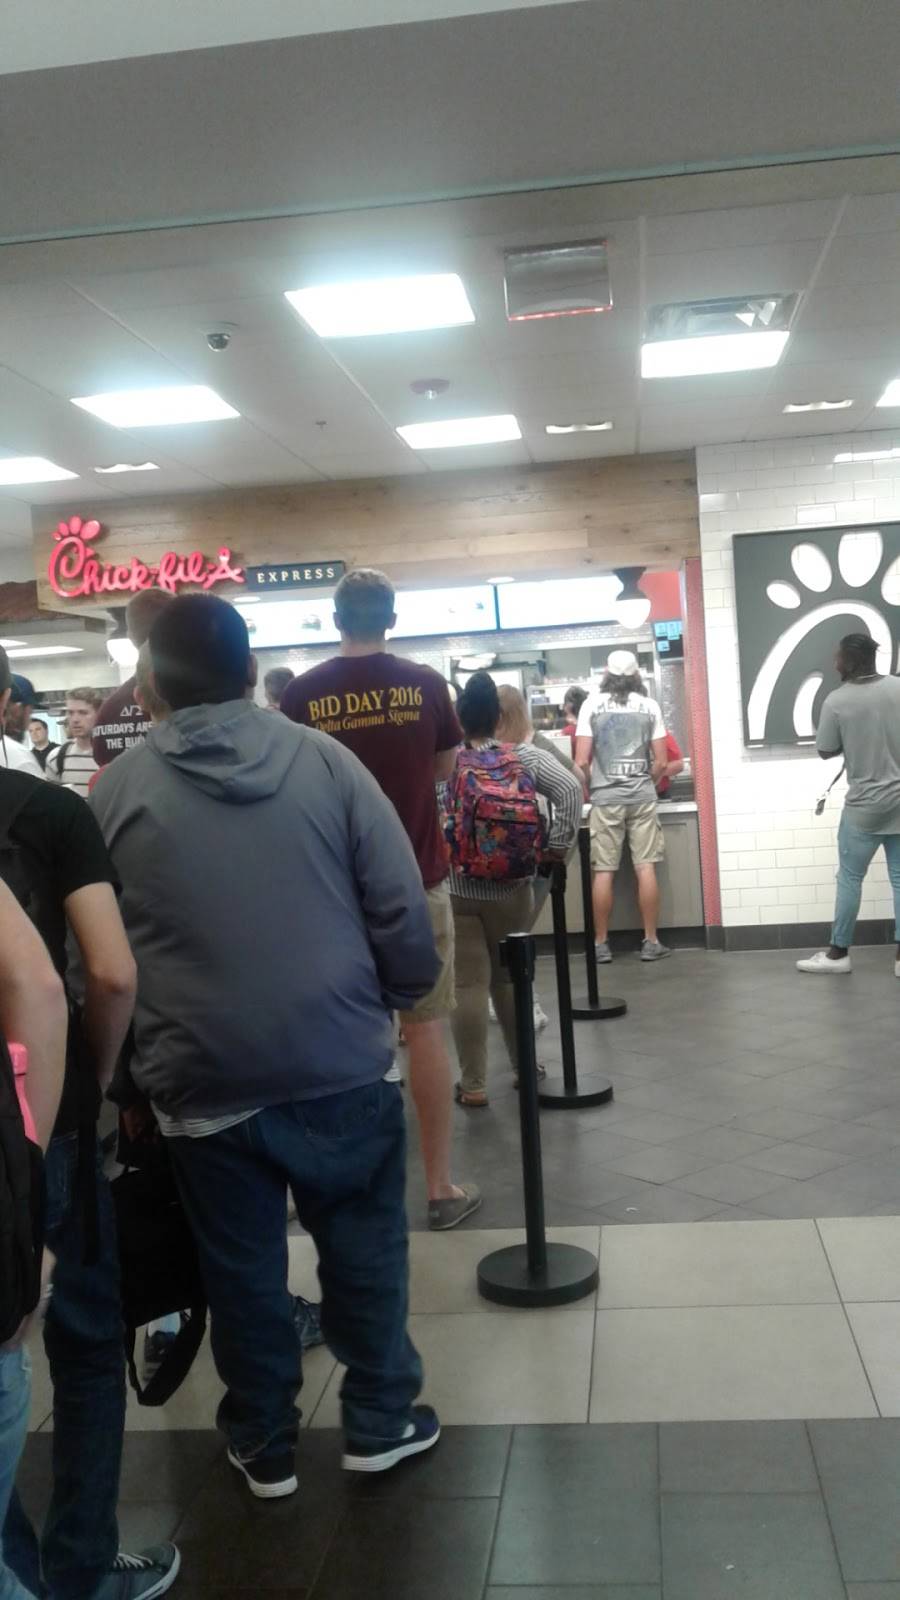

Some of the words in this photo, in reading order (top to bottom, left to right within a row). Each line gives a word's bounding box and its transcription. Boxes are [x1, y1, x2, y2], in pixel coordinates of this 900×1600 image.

[49, 516, 246, 598] Chick-fil-A
[257, 567, 336, 584] EXPRESS
[308, 695, 341, 721] BID
[345, 689, 385, 714] DAY
[388, 686, 423, 707] 2016
[342, 714, 385, 730] Gamma
[388, 710, 420, 726] Sigma
[92, 722, 135, 738] ATURDAYS
[106, 737, 124, 750] THE
